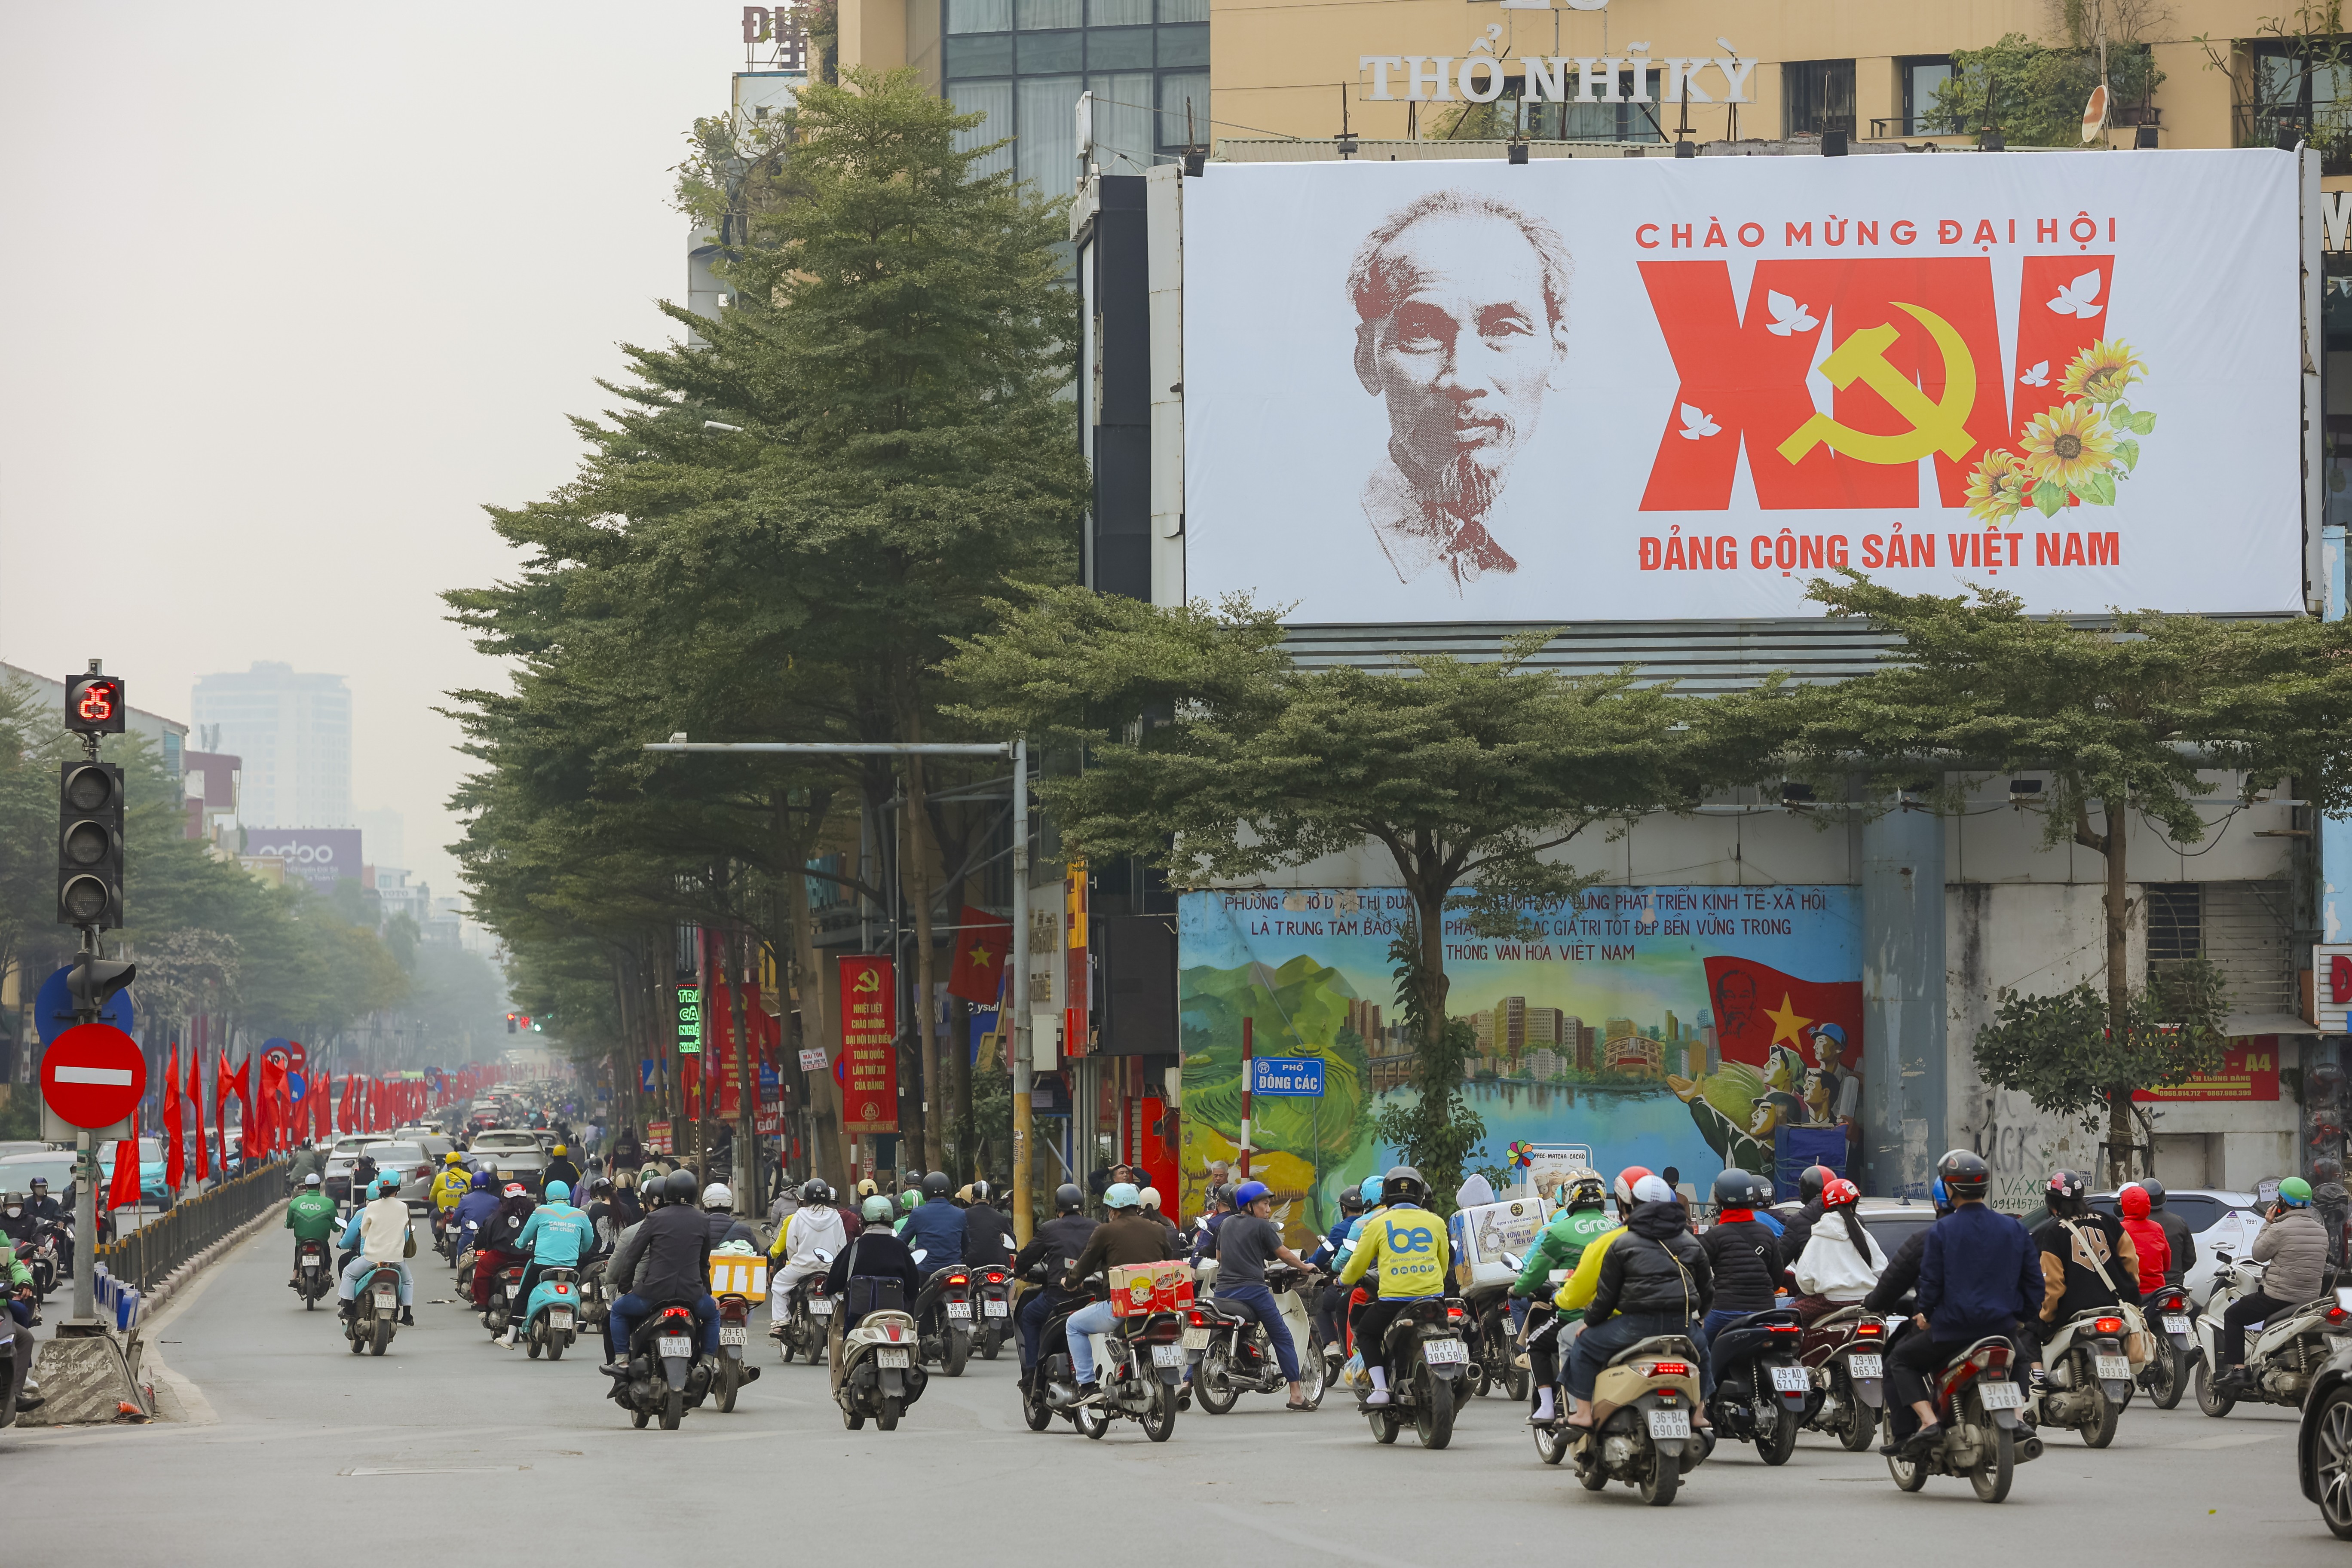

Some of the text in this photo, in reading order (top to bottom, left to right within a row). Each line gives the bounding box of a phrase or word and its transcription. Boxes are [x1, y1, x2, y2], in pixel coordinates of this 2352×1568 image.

[1360, 23, 1758, 104] THỔ NHĨ KỲ
[1636, 211, 2116, 252] CHÀO MỪNG ĐẠI HỘI
[1636, 254, 2116, 512] XIV
[1639, 522, 2119, 578] ĐẢNG CỘNG SẢN VIỆT NAM
[1656, 886, 1697, 910] TRIỂN
[1703, 890, 1738, 910] KINH
[1801, 888, 1825, 915] HỘI
[1251, 915, 1270, 935] LÀ
[1275, 921, 1323, 935] TRUNG
[1605, 913, 1630, 935] TỐT
[1664, 913, 1690, 935] BỀN
[1696, 912, 1735, 935] VỮNG
[1741, 919, 1791, 935] TRONG
[1446, 937, 1488, 960] THỐNG
[1559, 939, 1595, 965] VIỆT
[1602, 944, 1635, 961] NAM
[680, 1005, 699, 1021] CÂ
[853, 1002, 882, 1015] NHIỆT LIỆT
[968, 1002, 999, 1014] Cystal
[851, 1017, 885, 1029] CHÀO MỪNG
[679, 1022, 700, 1038] NHẬ
[846, 1031, 891, 1046] ĐẠI HỘI ĐẠI BIỂU
[679, 1038, 700, 1053] KHẨ
[853, 1047, 885, 1060] TOÀN QUỐC
[1282, 1062, 1305, 1071] PHỐ
[2245, 1053, 2272, 1072] A4
[865, 1064, 876, 1075] THỨ
[877, 1066, 886, 1074] XIV
[854, 1078, 885, 1090] CỦA ĐẢNG!
[1259, 1073, 1317, 1090] ĐÔNG CÁC
[847, 1123, 869, 1131] PHƯỜNG
[300, 1202, 321, 1211] Grab
[1385, 1220, 1433, 1254] be
[723, 1328, 743, 1336] 29-E1
[663, 1347, 689, 1355] 704.89
[1163, 1347, 1172, 1355] 31
[1430, 1341, 1452, 1352] 18-F1
[881, 1358, 906, 1366] 131.36
[1428, 1351, 1458, 1363] 389.58
[1854, 1356, 1877, 1365] 29-H1
[2101, 1358, 2124, 1367] 29-M1
[1776, 1369, 1801, 1378] 29-AD
[1853, 1366, 1882, 1376] 965.34
[2100, 1368, 2128, 1378] 993.82
[1776, 1379, 1807, 1390] 621.72
[1985, 1385, 2015, 1396] 37-V1
[1990, 1396, 2018, 1408] 2188
[1655, 1412, 1681, 1423] 36-B4
[1653, 1424, 1688, 1436] 690.80
